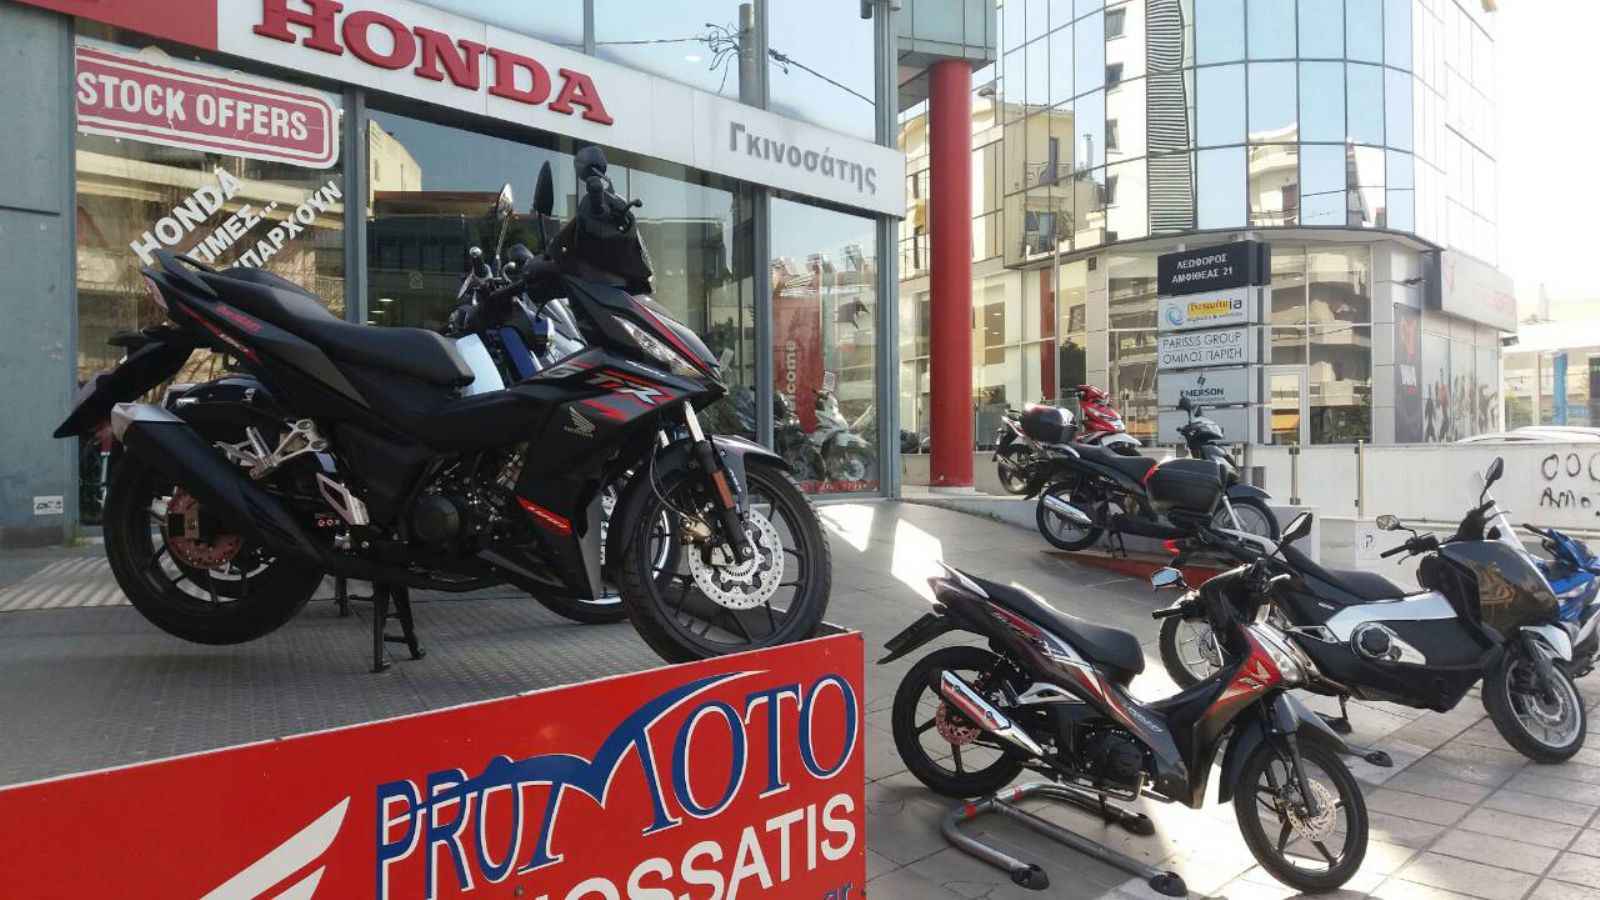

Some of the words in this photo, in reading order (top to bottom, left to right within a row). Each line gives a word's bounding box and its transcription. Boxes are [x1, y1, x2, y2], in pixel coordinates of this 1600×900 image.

[253, 0, 614, 126] HONDA
[77, 71, 187, 122] STOCK
[196, 94, 309, 142] OFFERS
[729, 121, 877, 195] Γκινοσάτης
[130, 168, 244, 266] HONDA
[233, 180, 342, 268] ΠΑΡΧΟΥΝ
[1223, 266, 1234, 276] 21
[1204, 332, 1242, 346] GROUP
[1180, 387, 1225, 398] EMERSON
[534, 793, 858, 900] SSATIS
